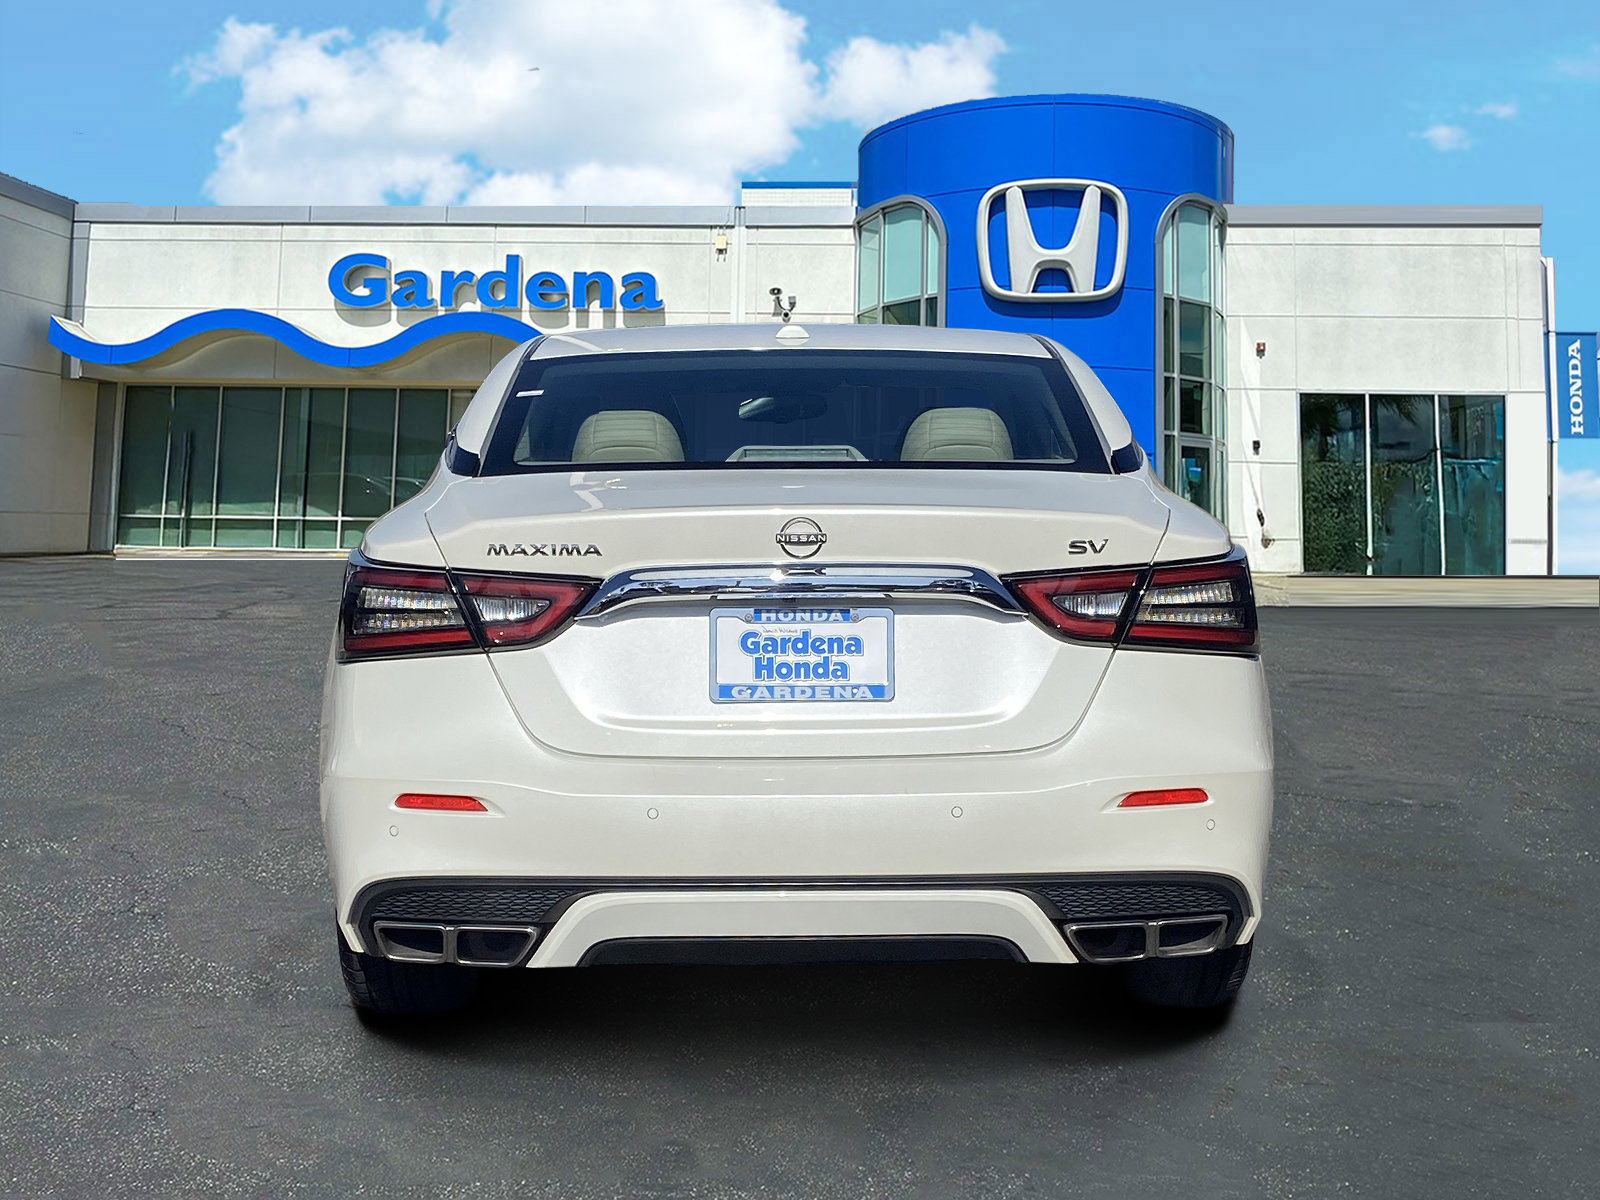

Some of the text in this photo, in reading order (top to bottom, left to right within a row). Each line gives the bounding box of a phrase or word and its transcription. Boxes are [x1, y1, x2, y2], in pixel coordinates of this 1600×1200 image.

[328, 253, 663, 310] Gardena
[1568, 339, 1584, 435] HONDA
[776, 534, 826, 542] NISSAN
[1068, 538, 1109, 555] SV
[486, 543, 603, 557] MAXIMA
[760, 609, 844, 622] HONDA
[739, 628, 863, 656] Gardena
[754, 656, 849, 681] Honda
[731, 686, 874, 699] GARDENA
